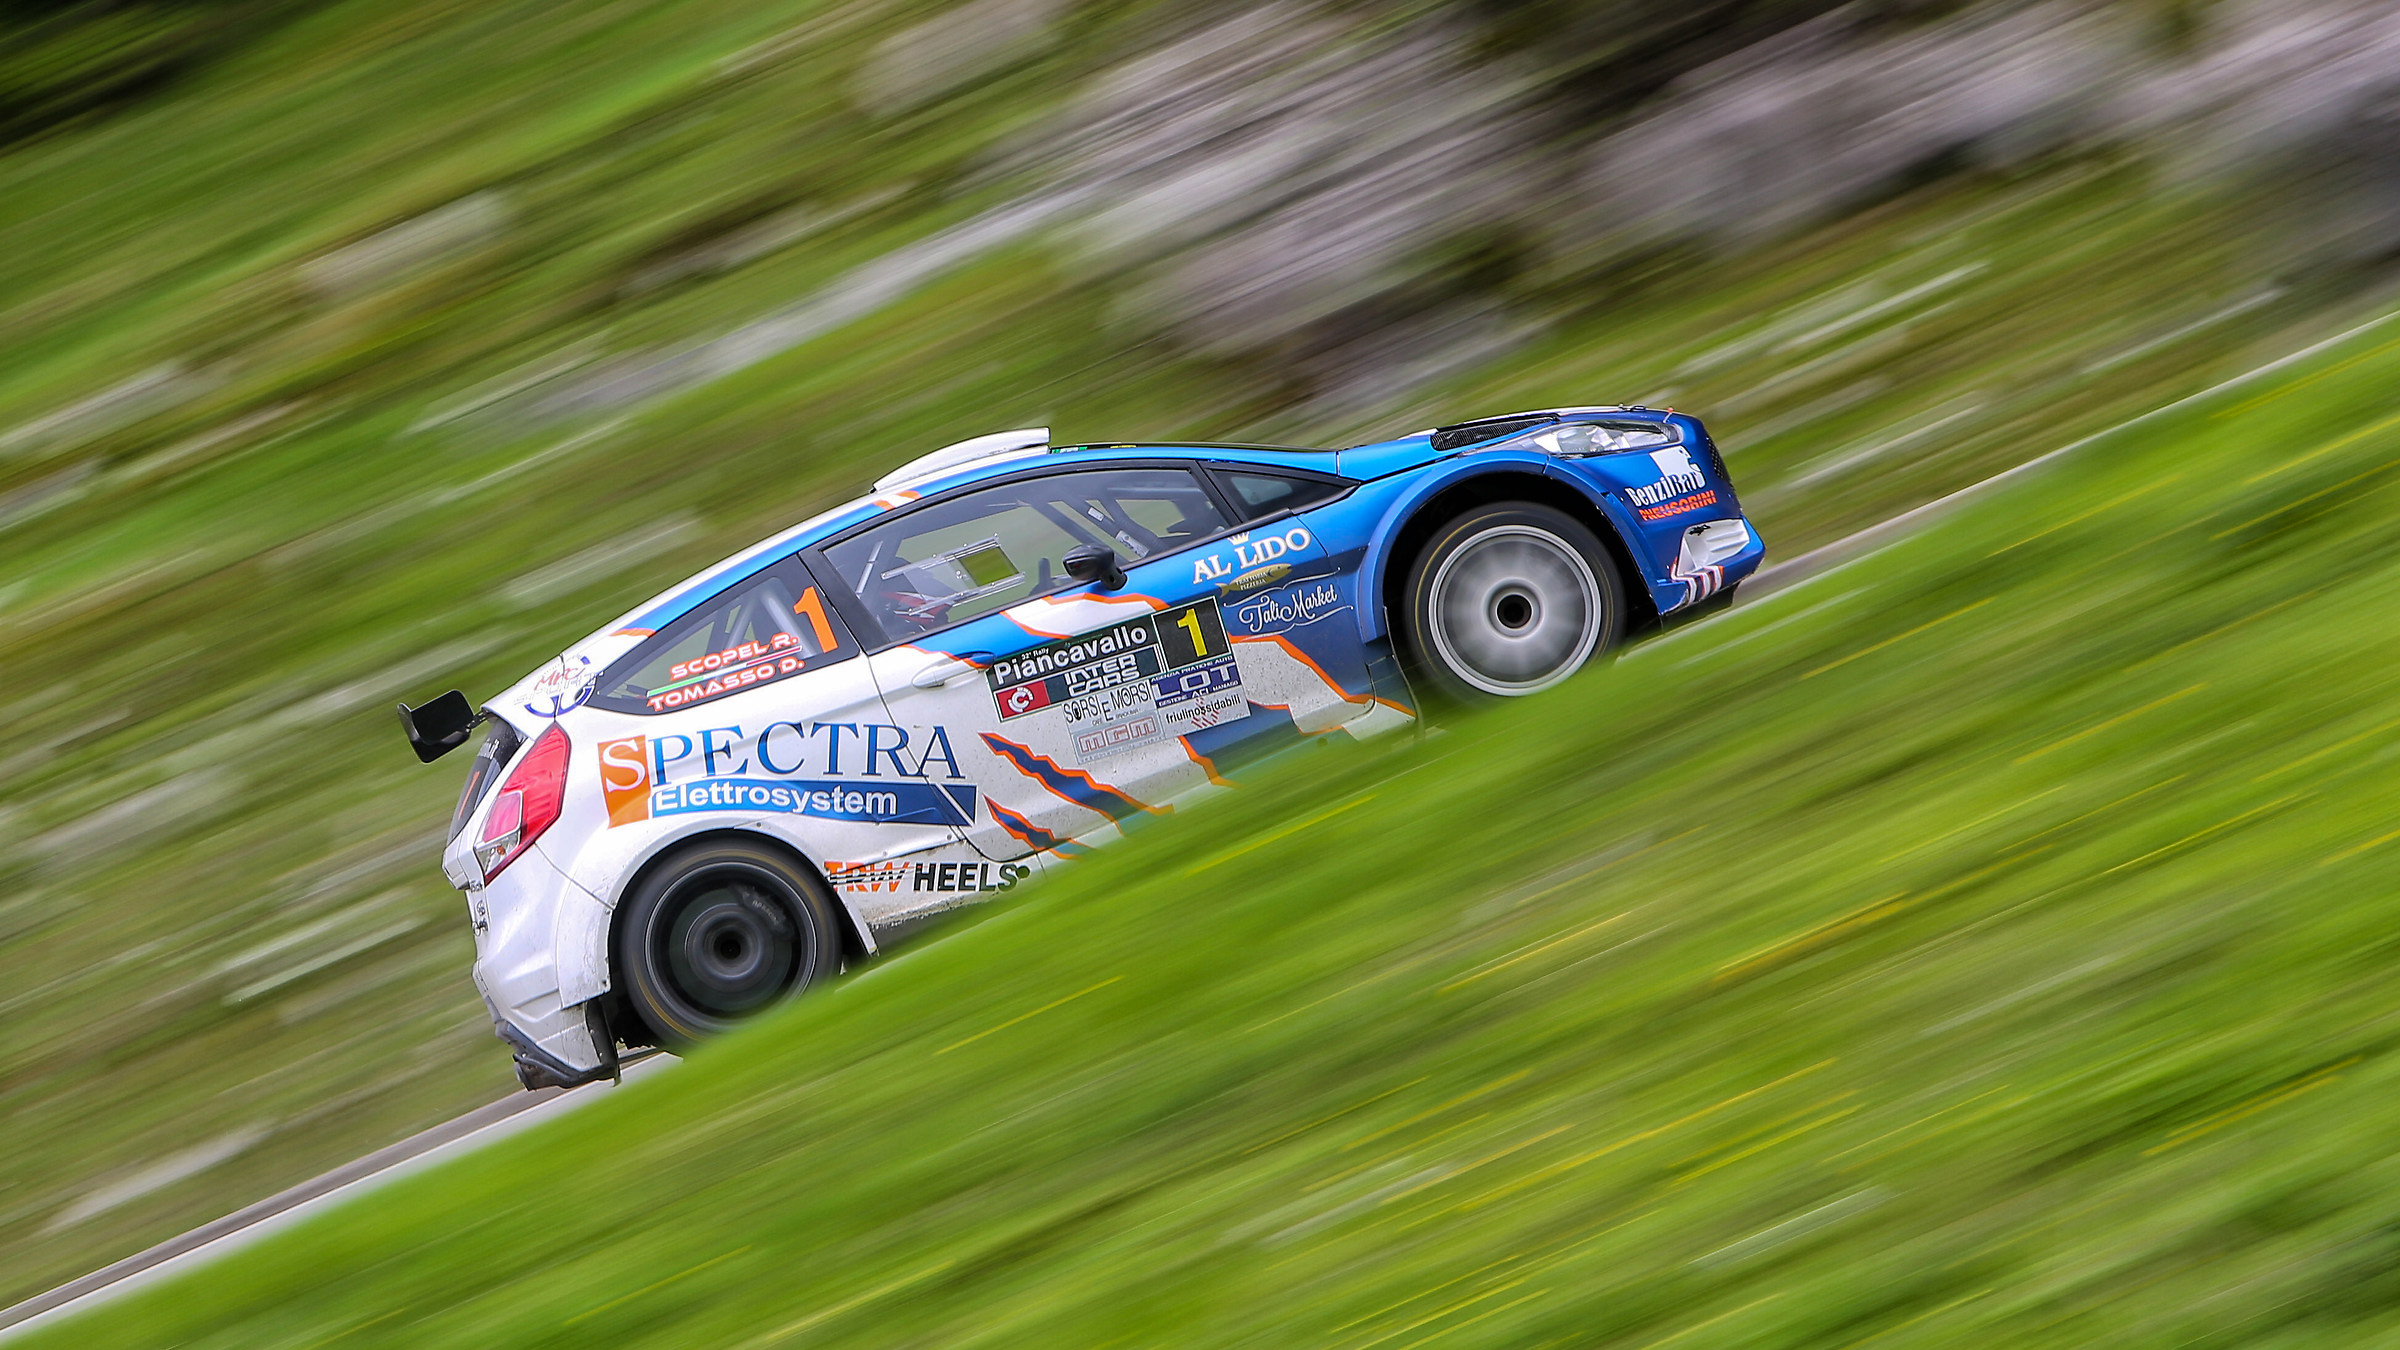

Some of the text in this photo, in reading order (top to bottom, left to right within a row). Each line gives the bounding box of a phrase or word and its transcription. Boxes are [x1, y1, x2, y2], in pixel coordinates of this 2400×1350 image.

[1193, 527, 1311, 584] AL LIDO
[1236, 572, 1267, 586] TRATTORIA
[1240, 579, 1266, 591] PIZZERIA
[793, 586, 838, 653] 1
[1176, 608, 1207, 657] 1
[671, 632, 800, 680] SCOPEL R.
[993, 625, 1148, 686] Piancavallo
[1033, 647, 1049, 658] Rally
[1064, 654, 1137, 686] INTER
[1151, 655, 1233, 682] AGENZIA PRATICHE AUTO
[648, 656, 805, 711] TOMASSO D.
[1068, 666, 1140, 698] CARS
[1151, 662, 1236, 700] LOT
[1192, 687, 1209, 698] ACI
[1063, 681, 1152, 724] SORSI E MORSI
[1165, 694, 1241, 724] friulinossidabili
[601, 721, 966, 793] SPECTRA
[655, 781, 898, 815] Elettrosystem
